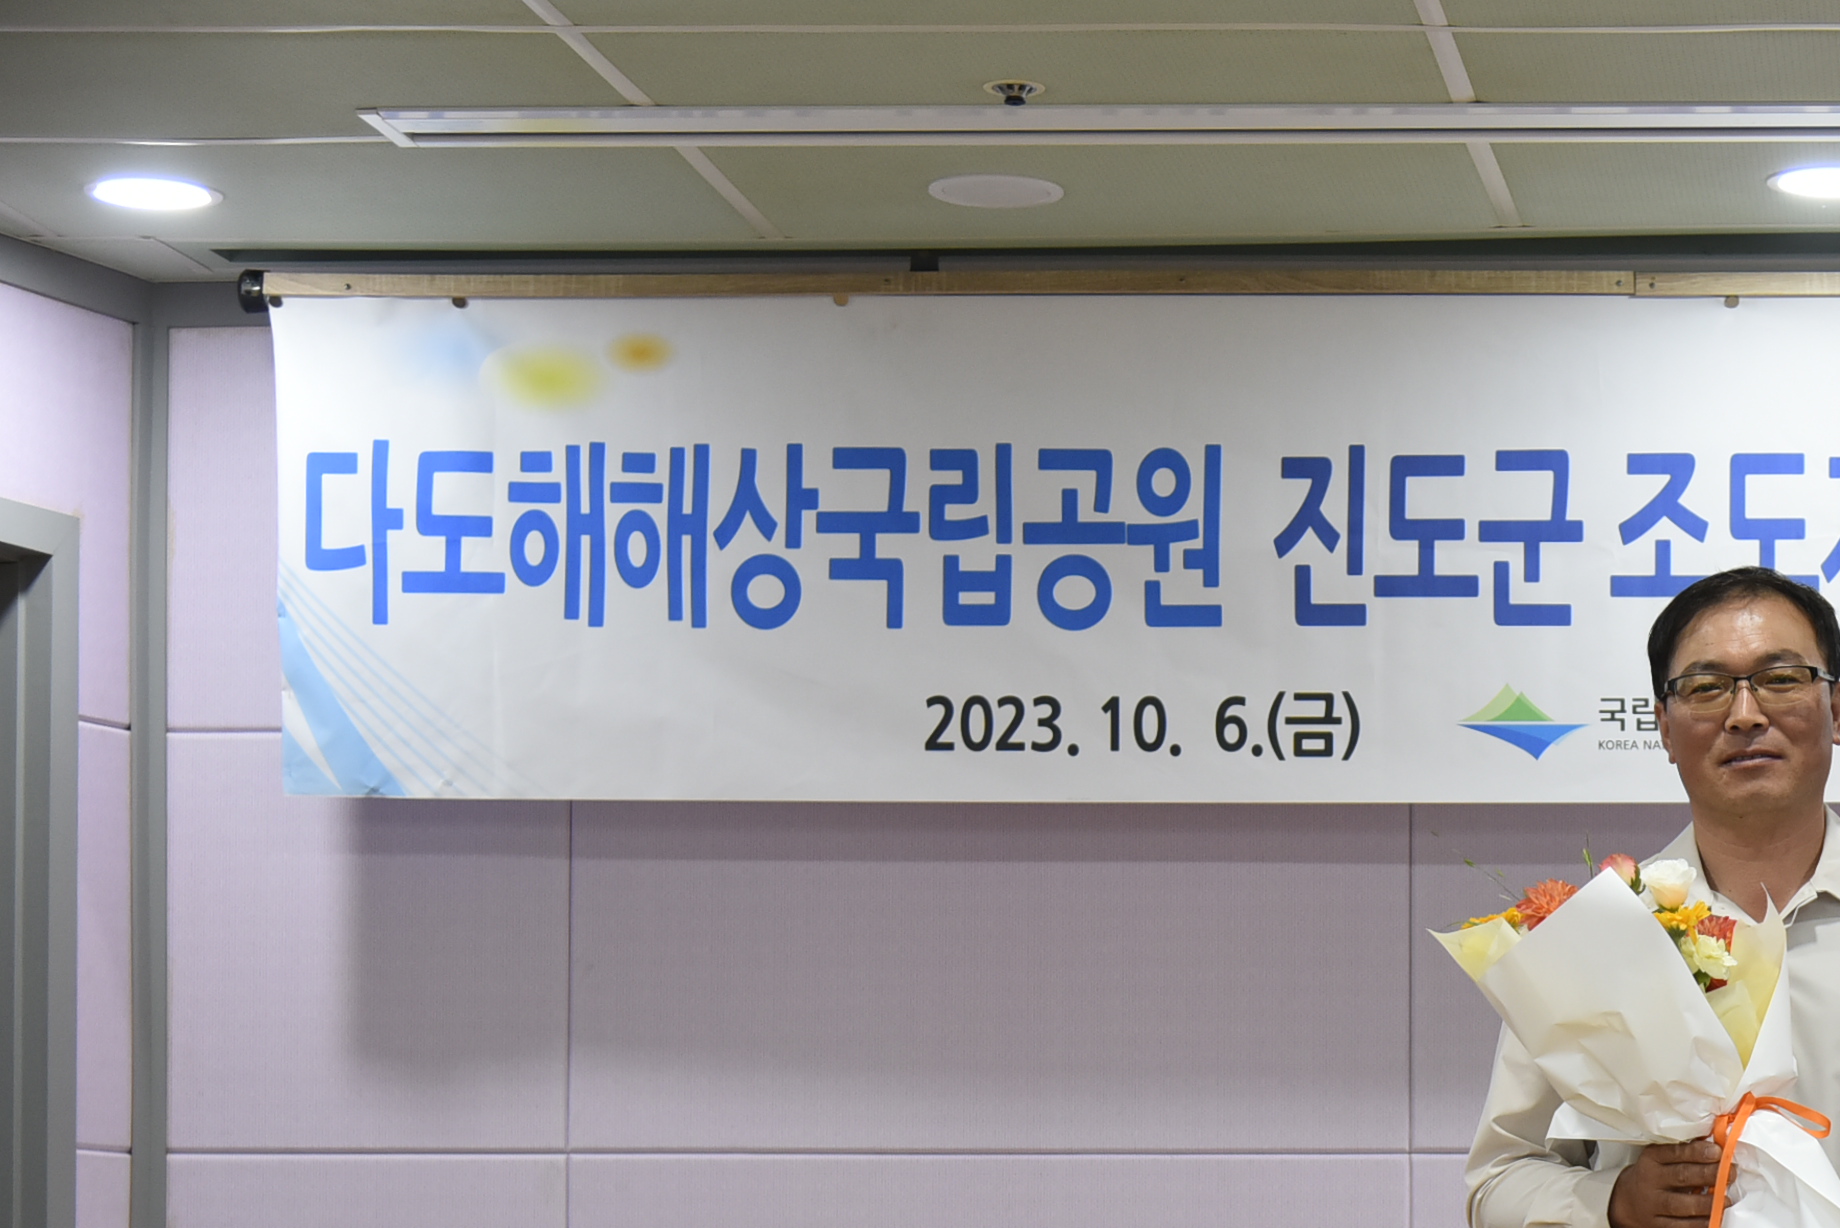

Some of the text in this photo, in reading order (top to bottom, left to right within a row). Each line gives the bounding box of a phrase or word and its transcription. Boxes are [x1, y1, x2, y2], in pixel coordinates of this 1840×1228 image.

[304, 438, 1223, 632] 다도해해상국립공원
[1274, 444, 1584, 627] 진도군
[924, 690, 1361, 761] 2023. 10. 6.(금)
[1598, 739, 1639, 751] KOREA
